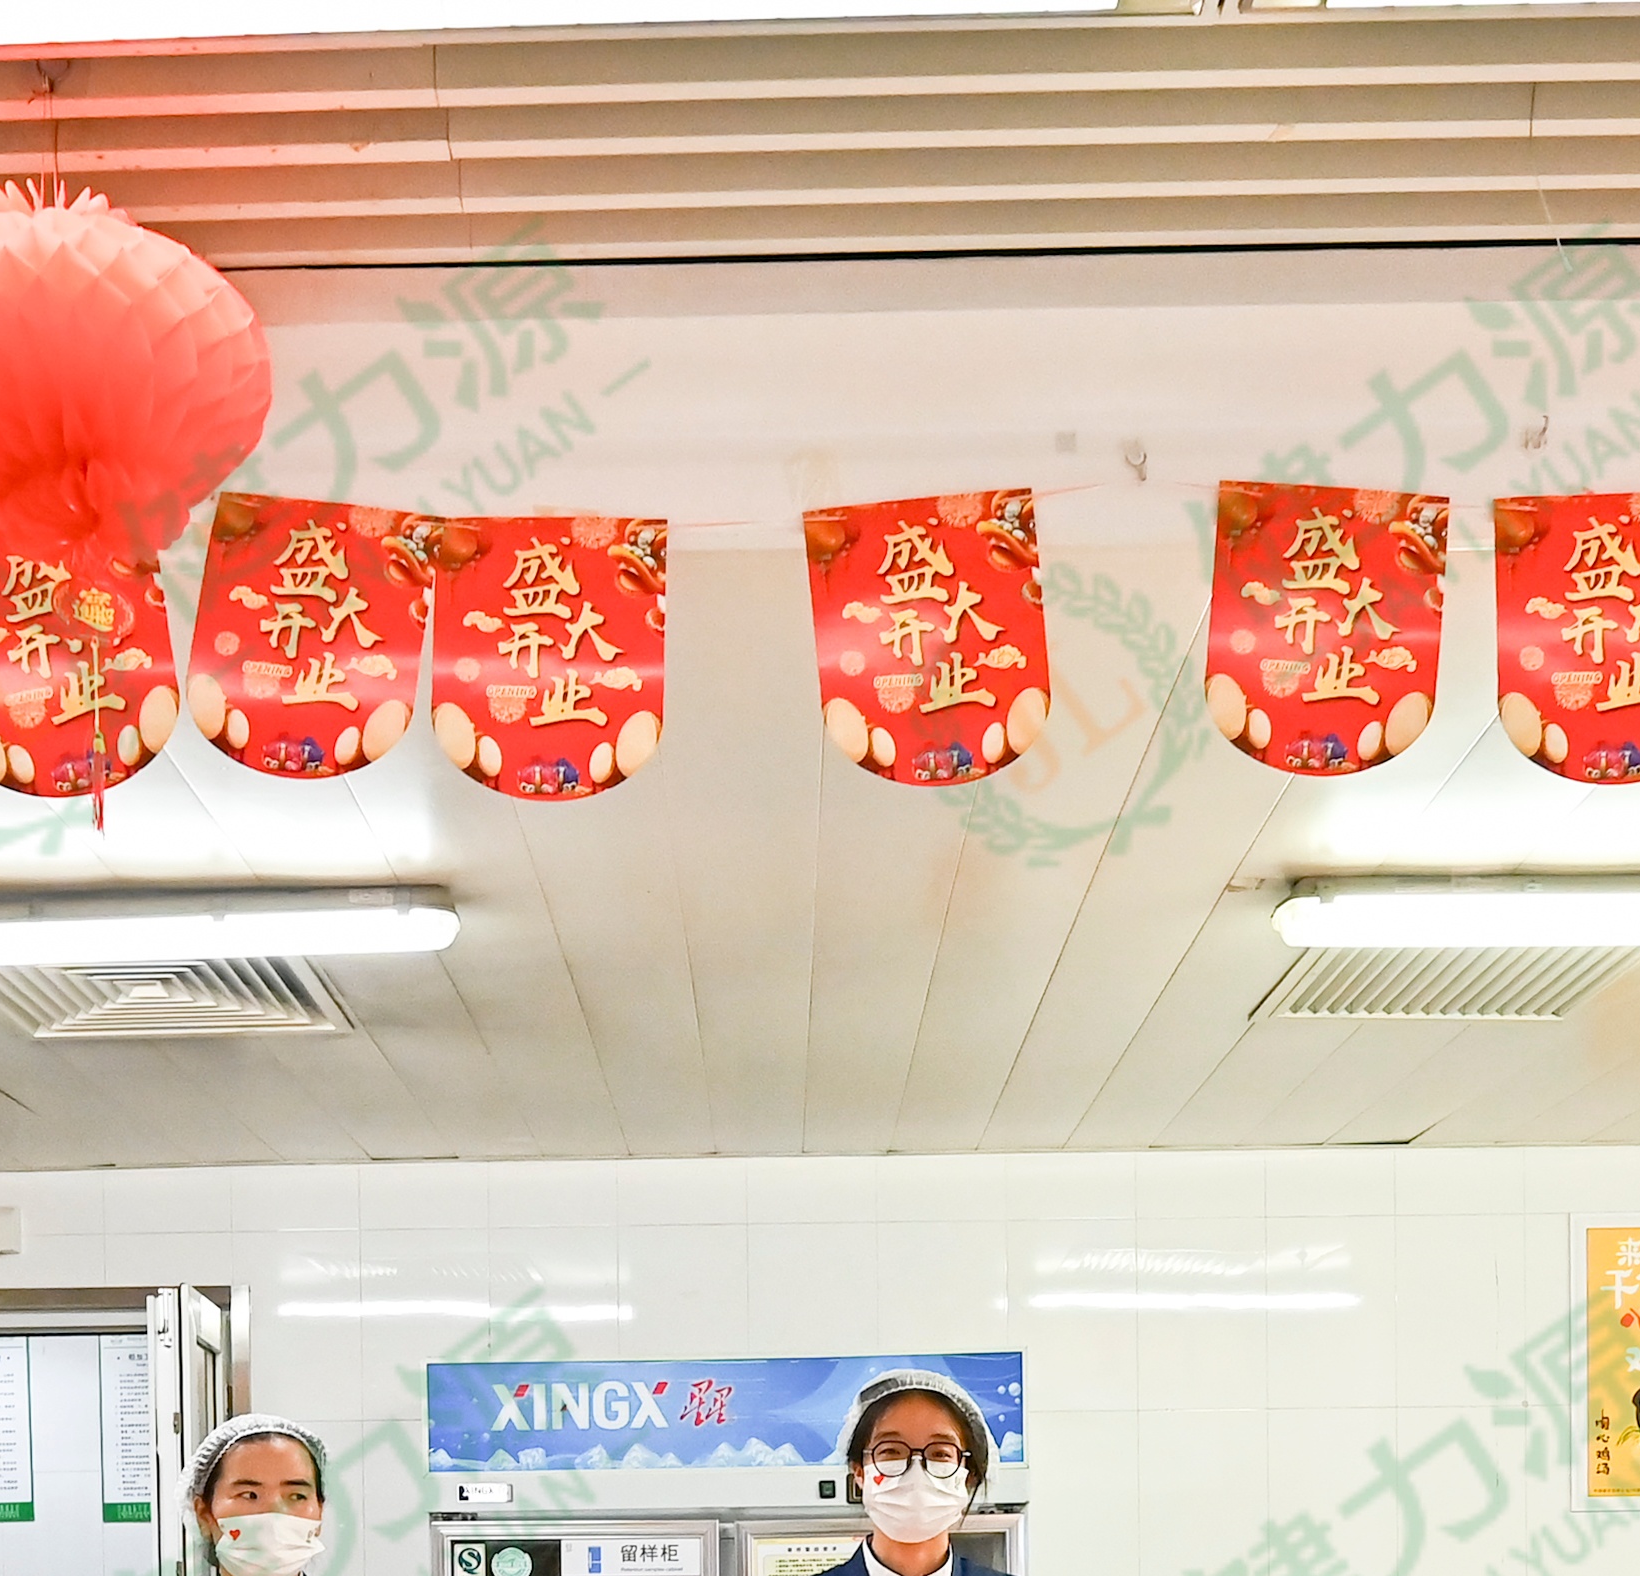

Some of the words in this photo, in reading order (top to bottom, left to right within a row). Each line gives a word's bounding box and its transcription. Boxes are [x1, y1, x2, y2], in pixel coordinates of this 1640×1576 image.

[872, 672, 923, 688] OPENING
[1550, 669, 1604, 686] OPENING
[486, 684, 538, 699] OPENING
[491, 1381, 671, 1432] XINGX
[620, 1544, 680, 1563] 留样柜
